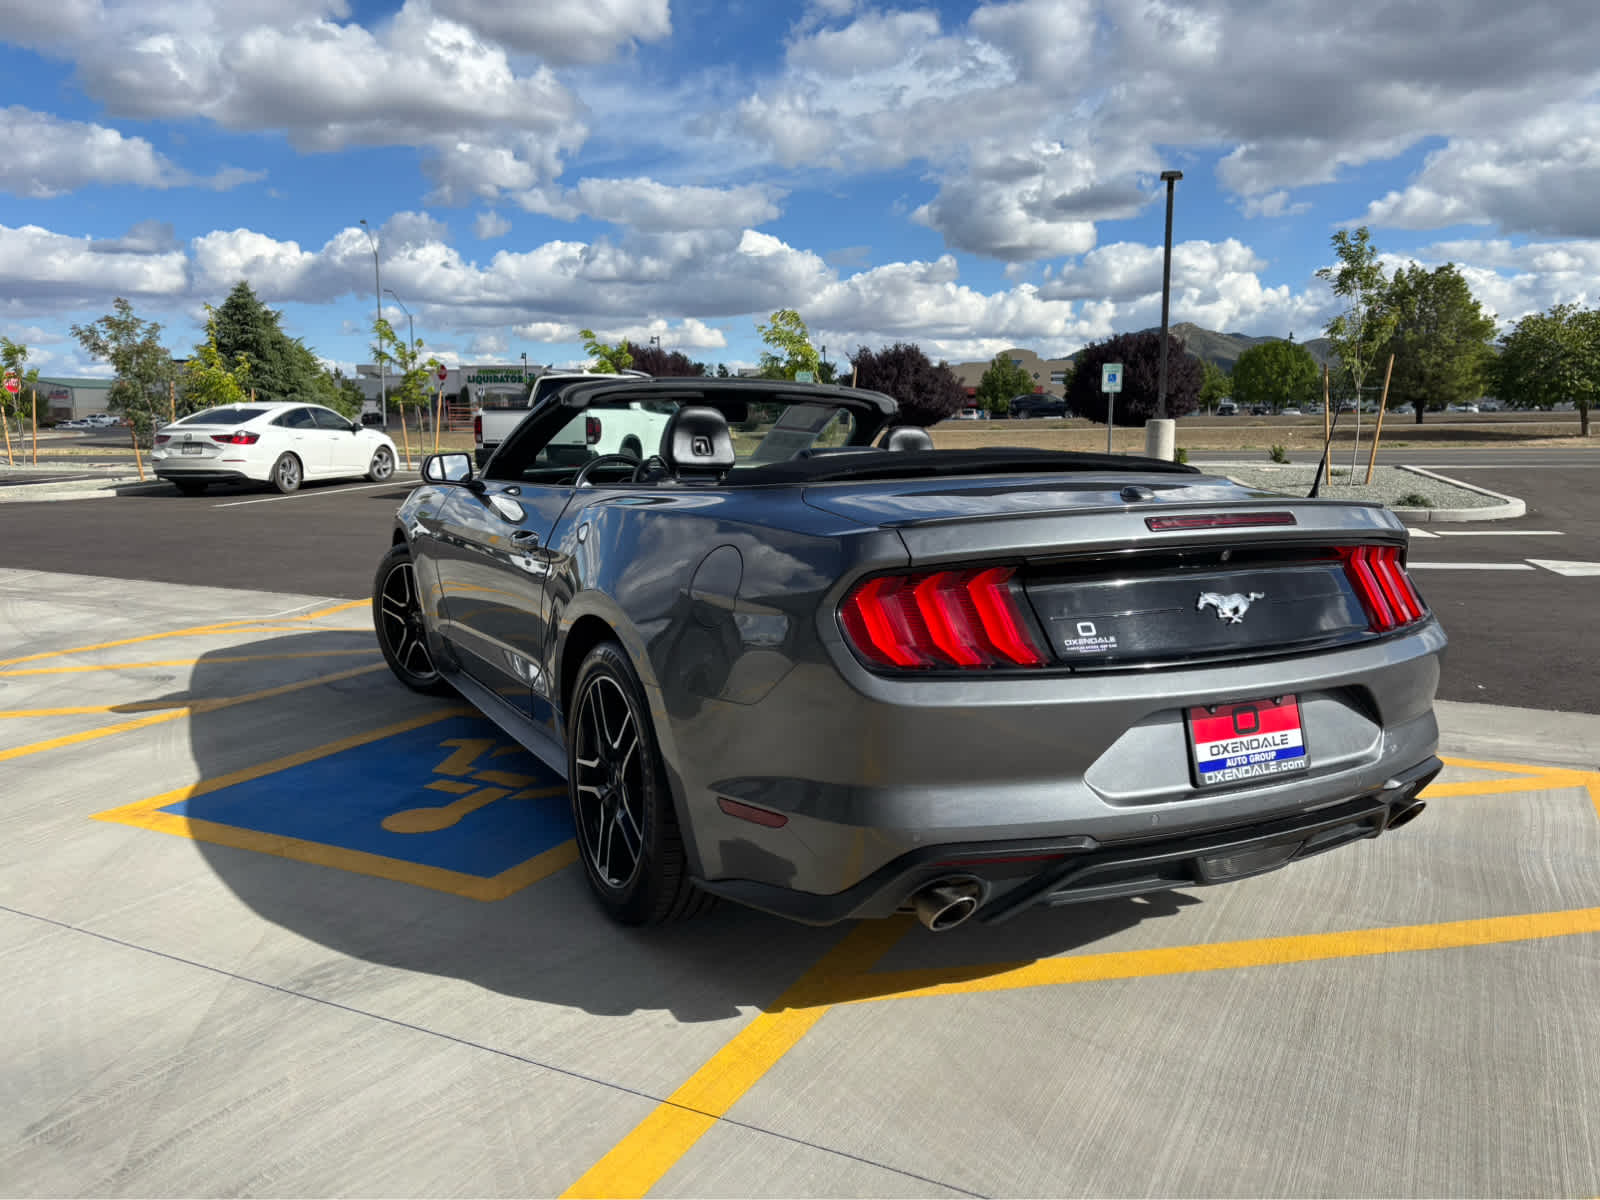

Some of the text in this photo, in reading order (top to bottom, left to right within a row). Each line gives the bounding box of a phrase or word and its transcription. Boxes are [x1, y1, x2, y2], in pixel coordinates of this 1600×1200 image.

[1210, 734, 1289, 756] OXENDALE
[1226, 751, 1277, 767] AUTO GROUP
[1205, 760, 1305, 784] OXENDALE.com
